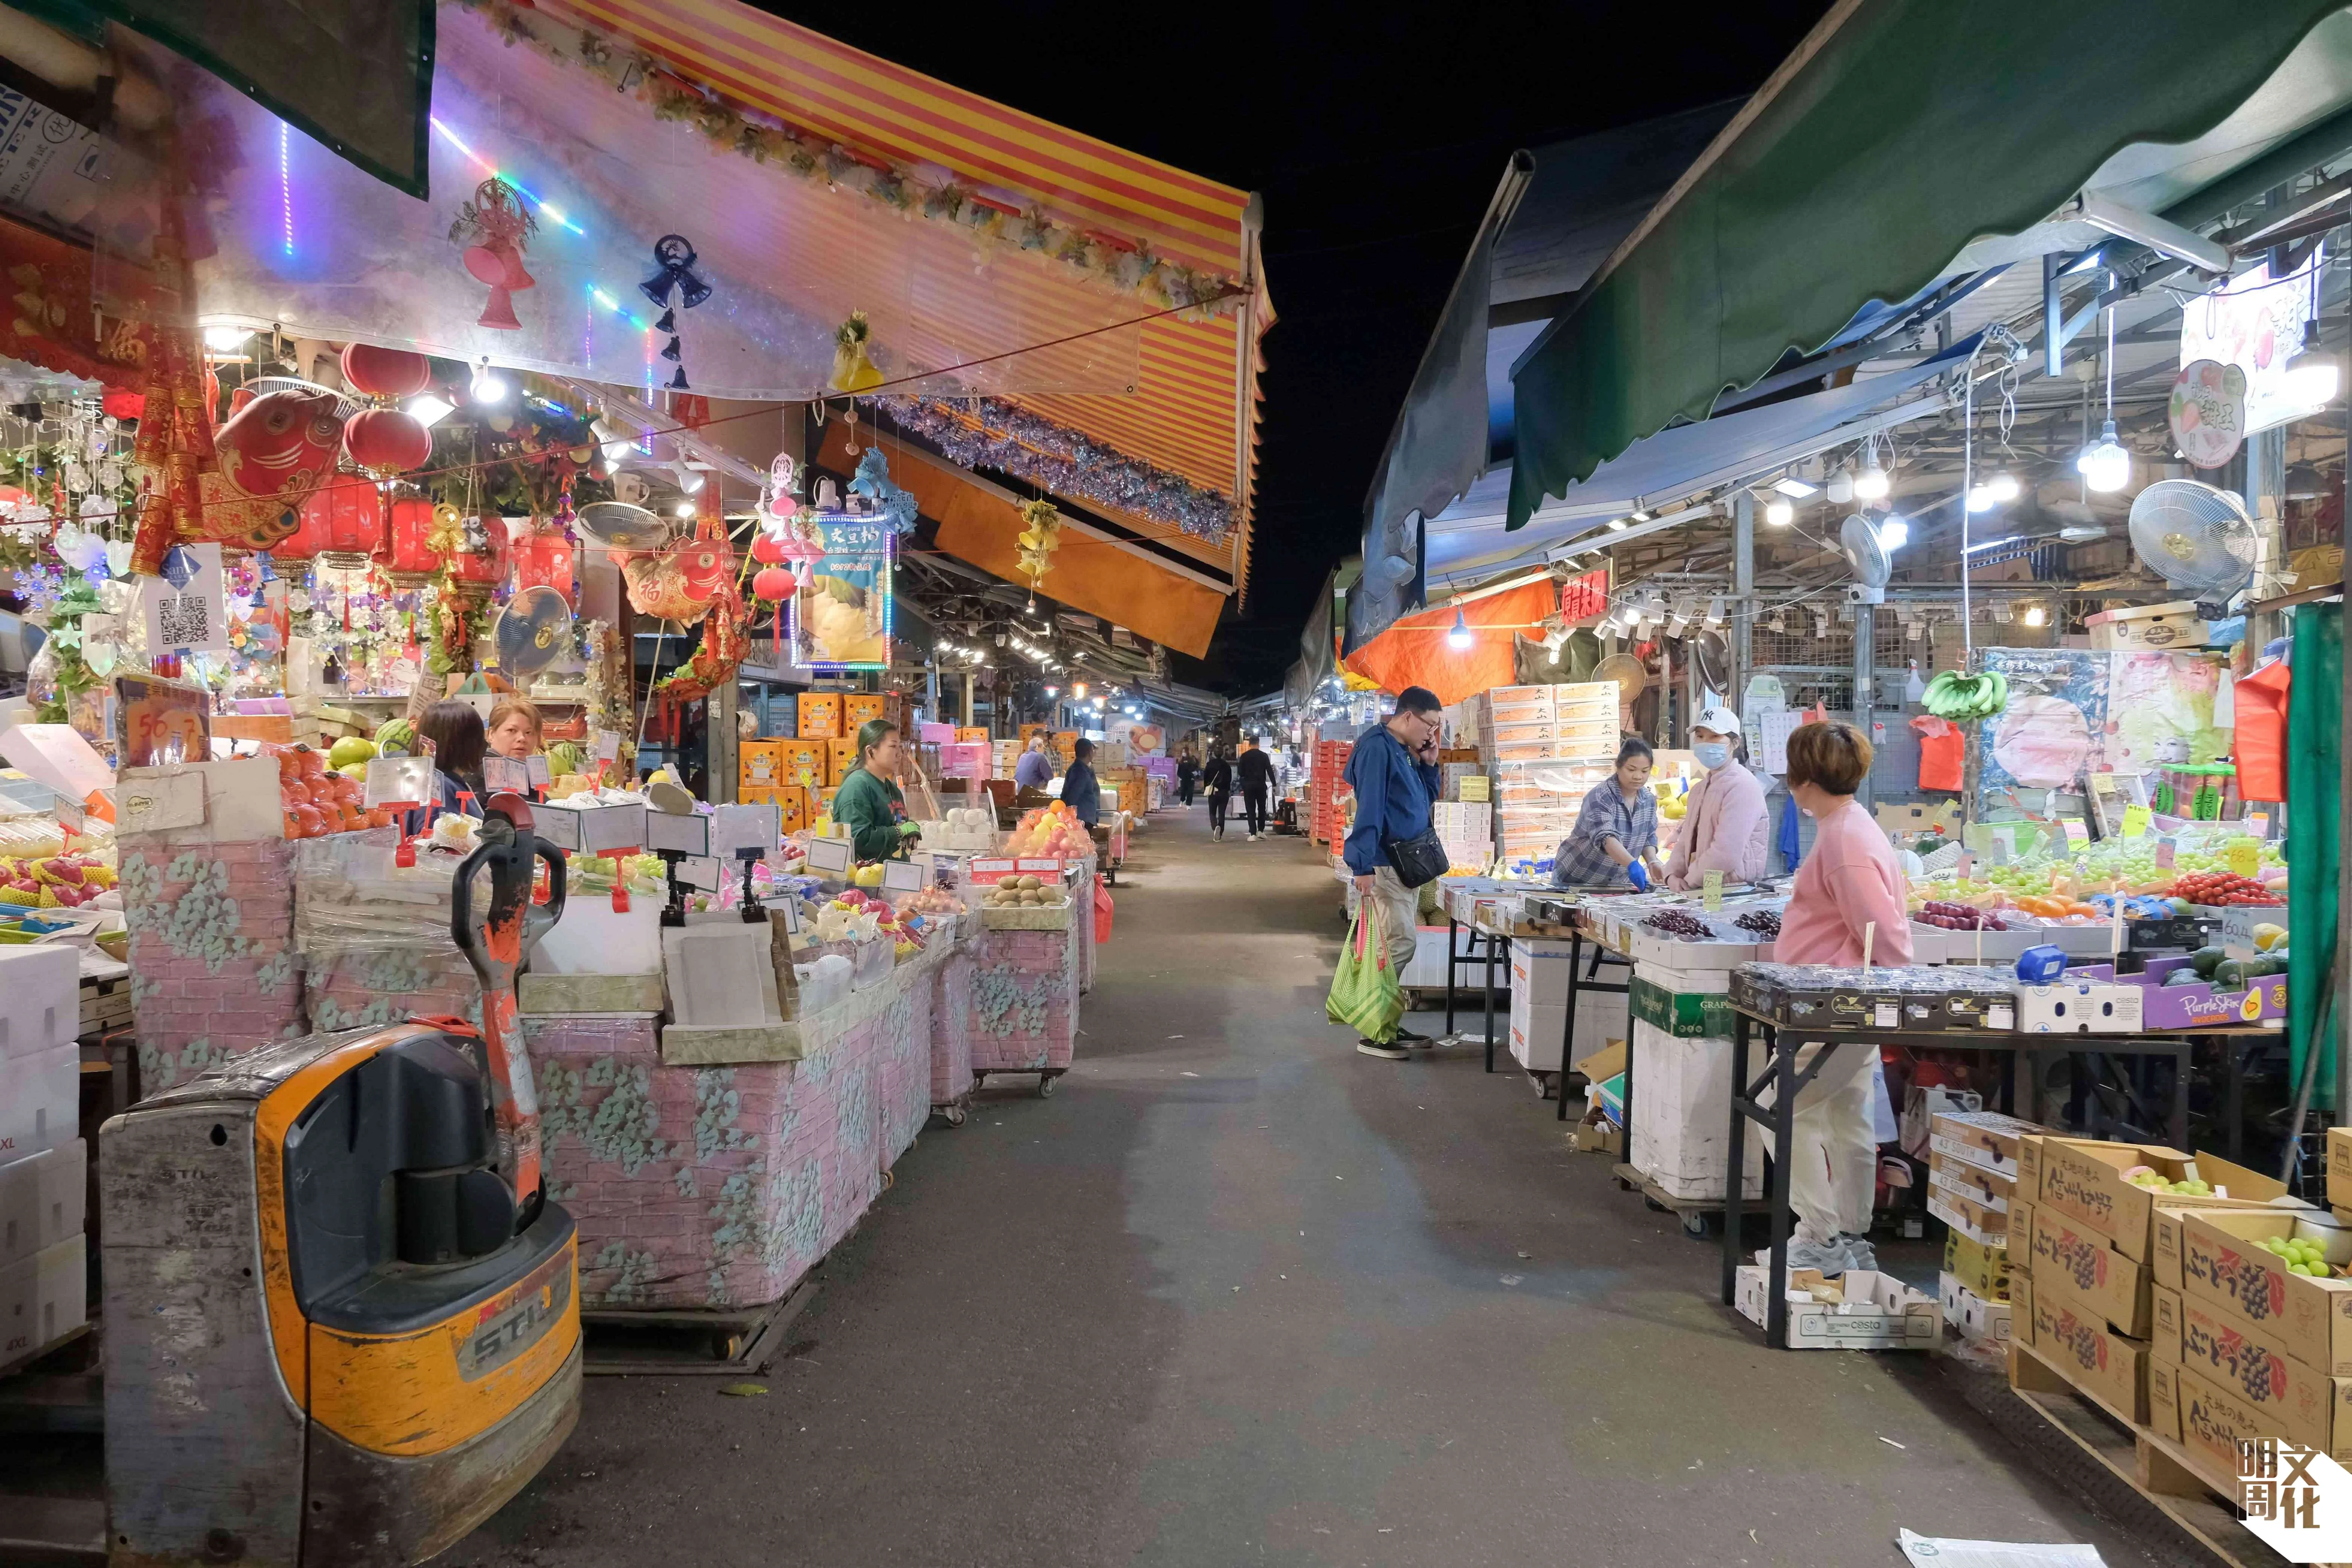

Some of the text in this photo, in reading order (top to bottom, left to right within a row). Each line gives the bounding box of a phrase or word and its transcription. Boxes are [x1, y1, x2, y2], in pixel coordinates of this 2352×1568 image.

[831, 525, 880, 544] 文旦柚
[161, 563, 194, 575] Sams
[640, 579, 660, 602] 福
[2179, 995, 2218, 1016] Purple
[2192, 1013, 2230, 1023] AVOCADOS
[1951, 1142, 1975, 1158] SOUTH
[1851, 1320, 1880, 1330] costa
[2203, 1390, 2260, 1434] 大地の恵み
